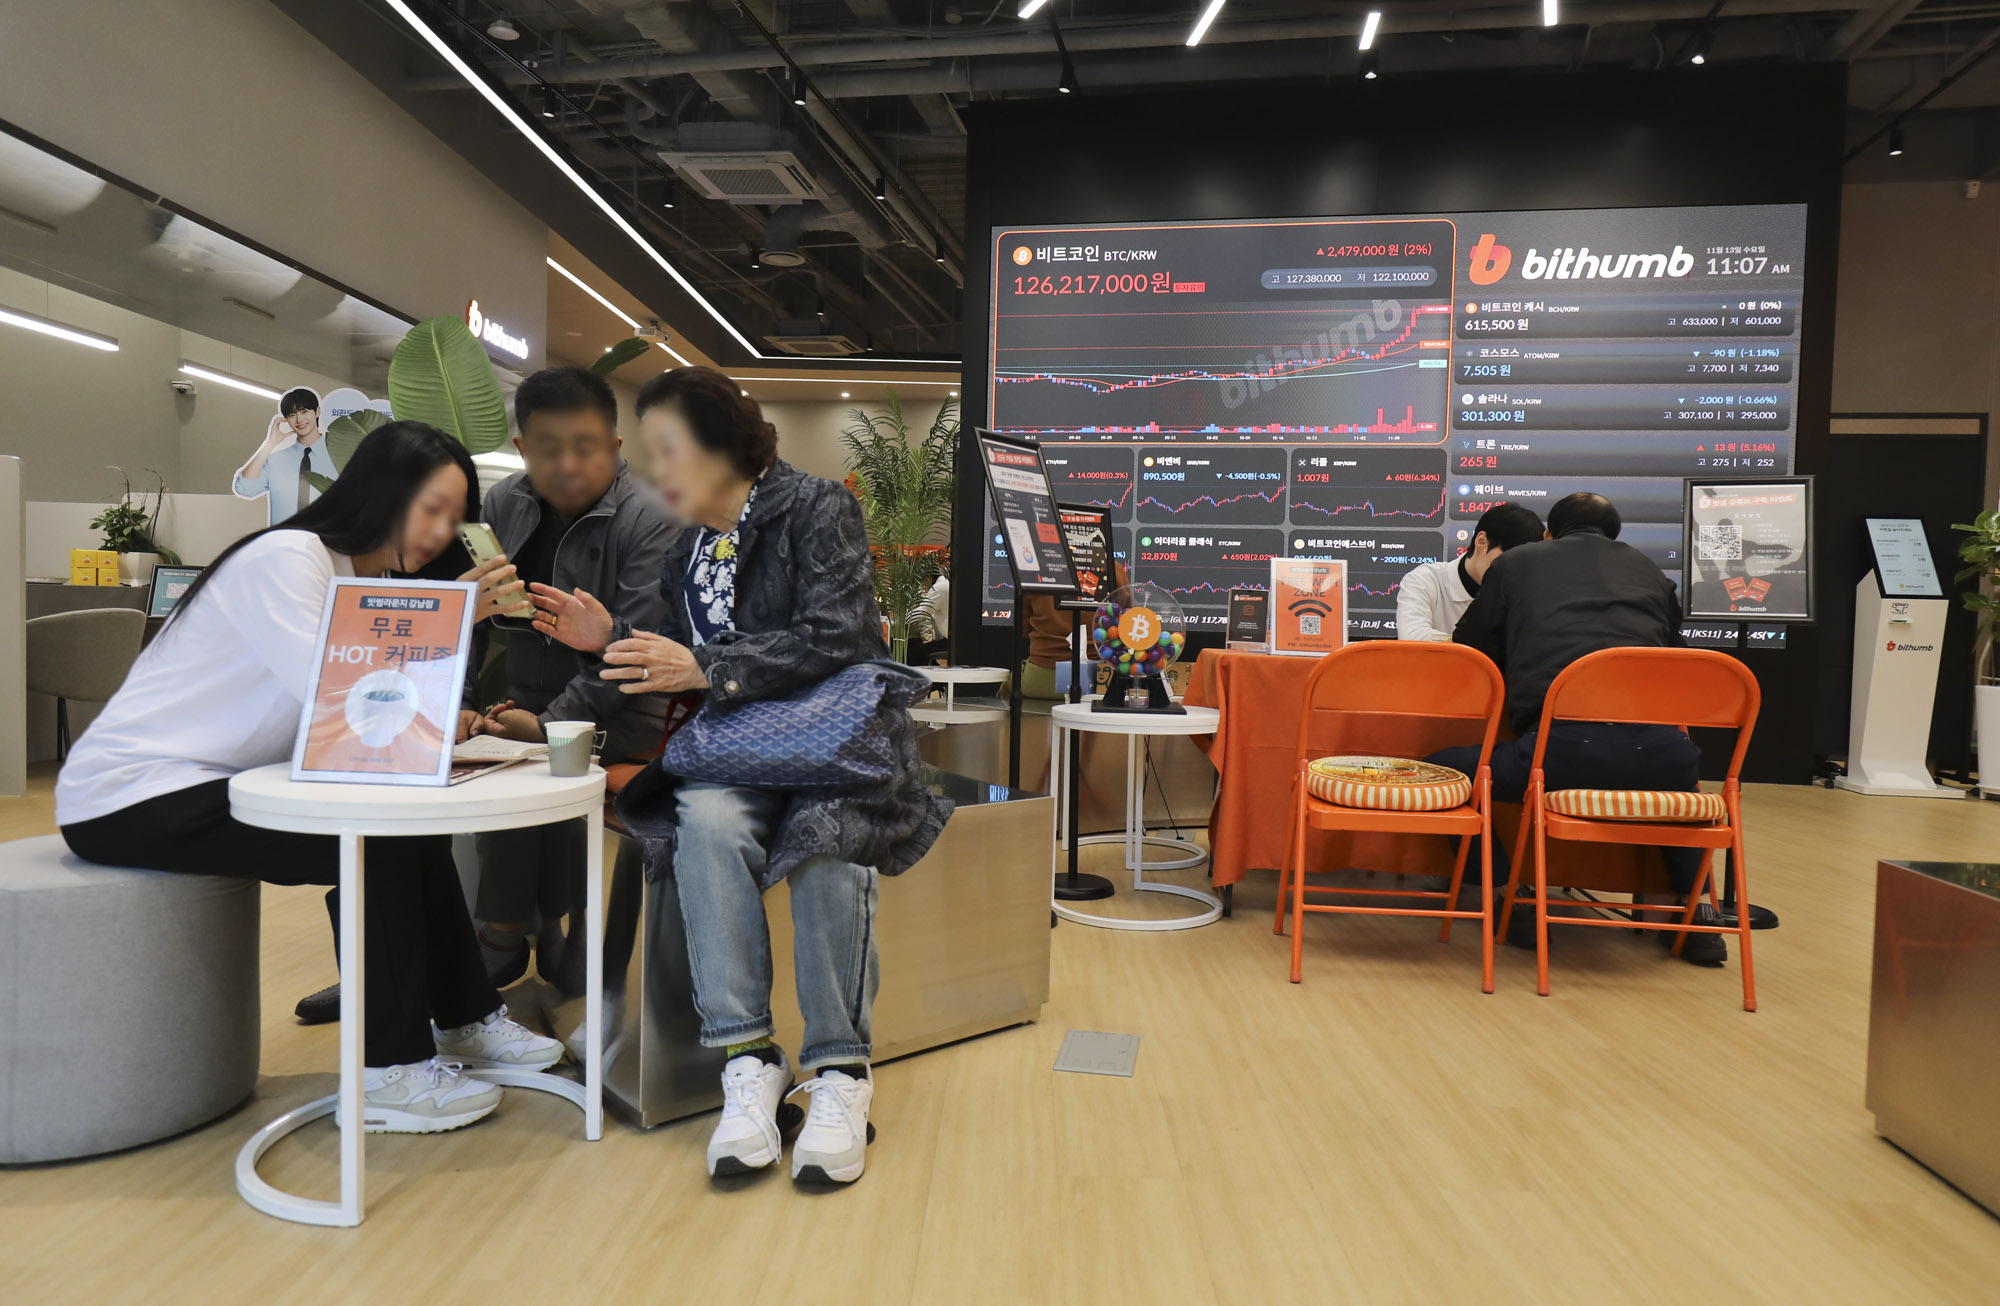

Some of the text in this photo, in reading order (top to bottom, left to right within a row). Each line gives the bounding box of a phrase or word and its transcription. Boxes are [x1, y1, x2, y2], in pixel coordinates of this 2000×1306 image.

[1036, 245, 1158, 263] 비트코인 BTC/KRW
[1404, 243, 1432, 256] (2%)
[1706, 245, 1766, 254] 11월 13일 수요일
[1521, 245, 1695, 280] bithumb
[1706, 257, 1790, 275] 11:07 AM
[1271, 272, 1429, 284] 고 127,380,000 저 122,100,000
[1481, 301, 1580, 313] 비트코인 캐시 BCH/KRW
[1760, 301, 1782, 311] (0%)
[1667, 317, 1782, 326] 고 633,000 저 601,000
[1480, 348, 1520, 359] 코스모스
[1740, 348, 1780, 358] (-1.18%)
[1687, 364, 1779, 373] 고 7,700 저 7,340
[1478, 394, 1508, 405] 솔라나
[1738, 396, 1777, 406] (-0.66%)
[1664, 411, 1777, 420] 고 307,100 저 295,000
[1476, 440, 1496, 450] 트론
[1740, 443, 1775, 452] (5.16%)
[1157, 457, 1181, 466] 비엔비
[1310, 458, 1328, 467] 리플
[1697, 458, 1775, 467] 고 275 저 252
[1474, 484, 1504, 494] 웨이브
[1154, 537, 1187, 546] 이더리움
[1188, 537, 1213, 547] 클래식
[1307, 539, 1376, 549] 비트코인에스브이
[1294, 588, 1325, 597] ZONE
[367, 597, 434, 609] 빗썸라운지 강남점
[370, 617, 413, 639] 무료
[1692, 629, 1722, 638] [KS11]
[1897, 644, 1934, 652] bithumb
[328, 645, 452, 669] HOT 커피존
